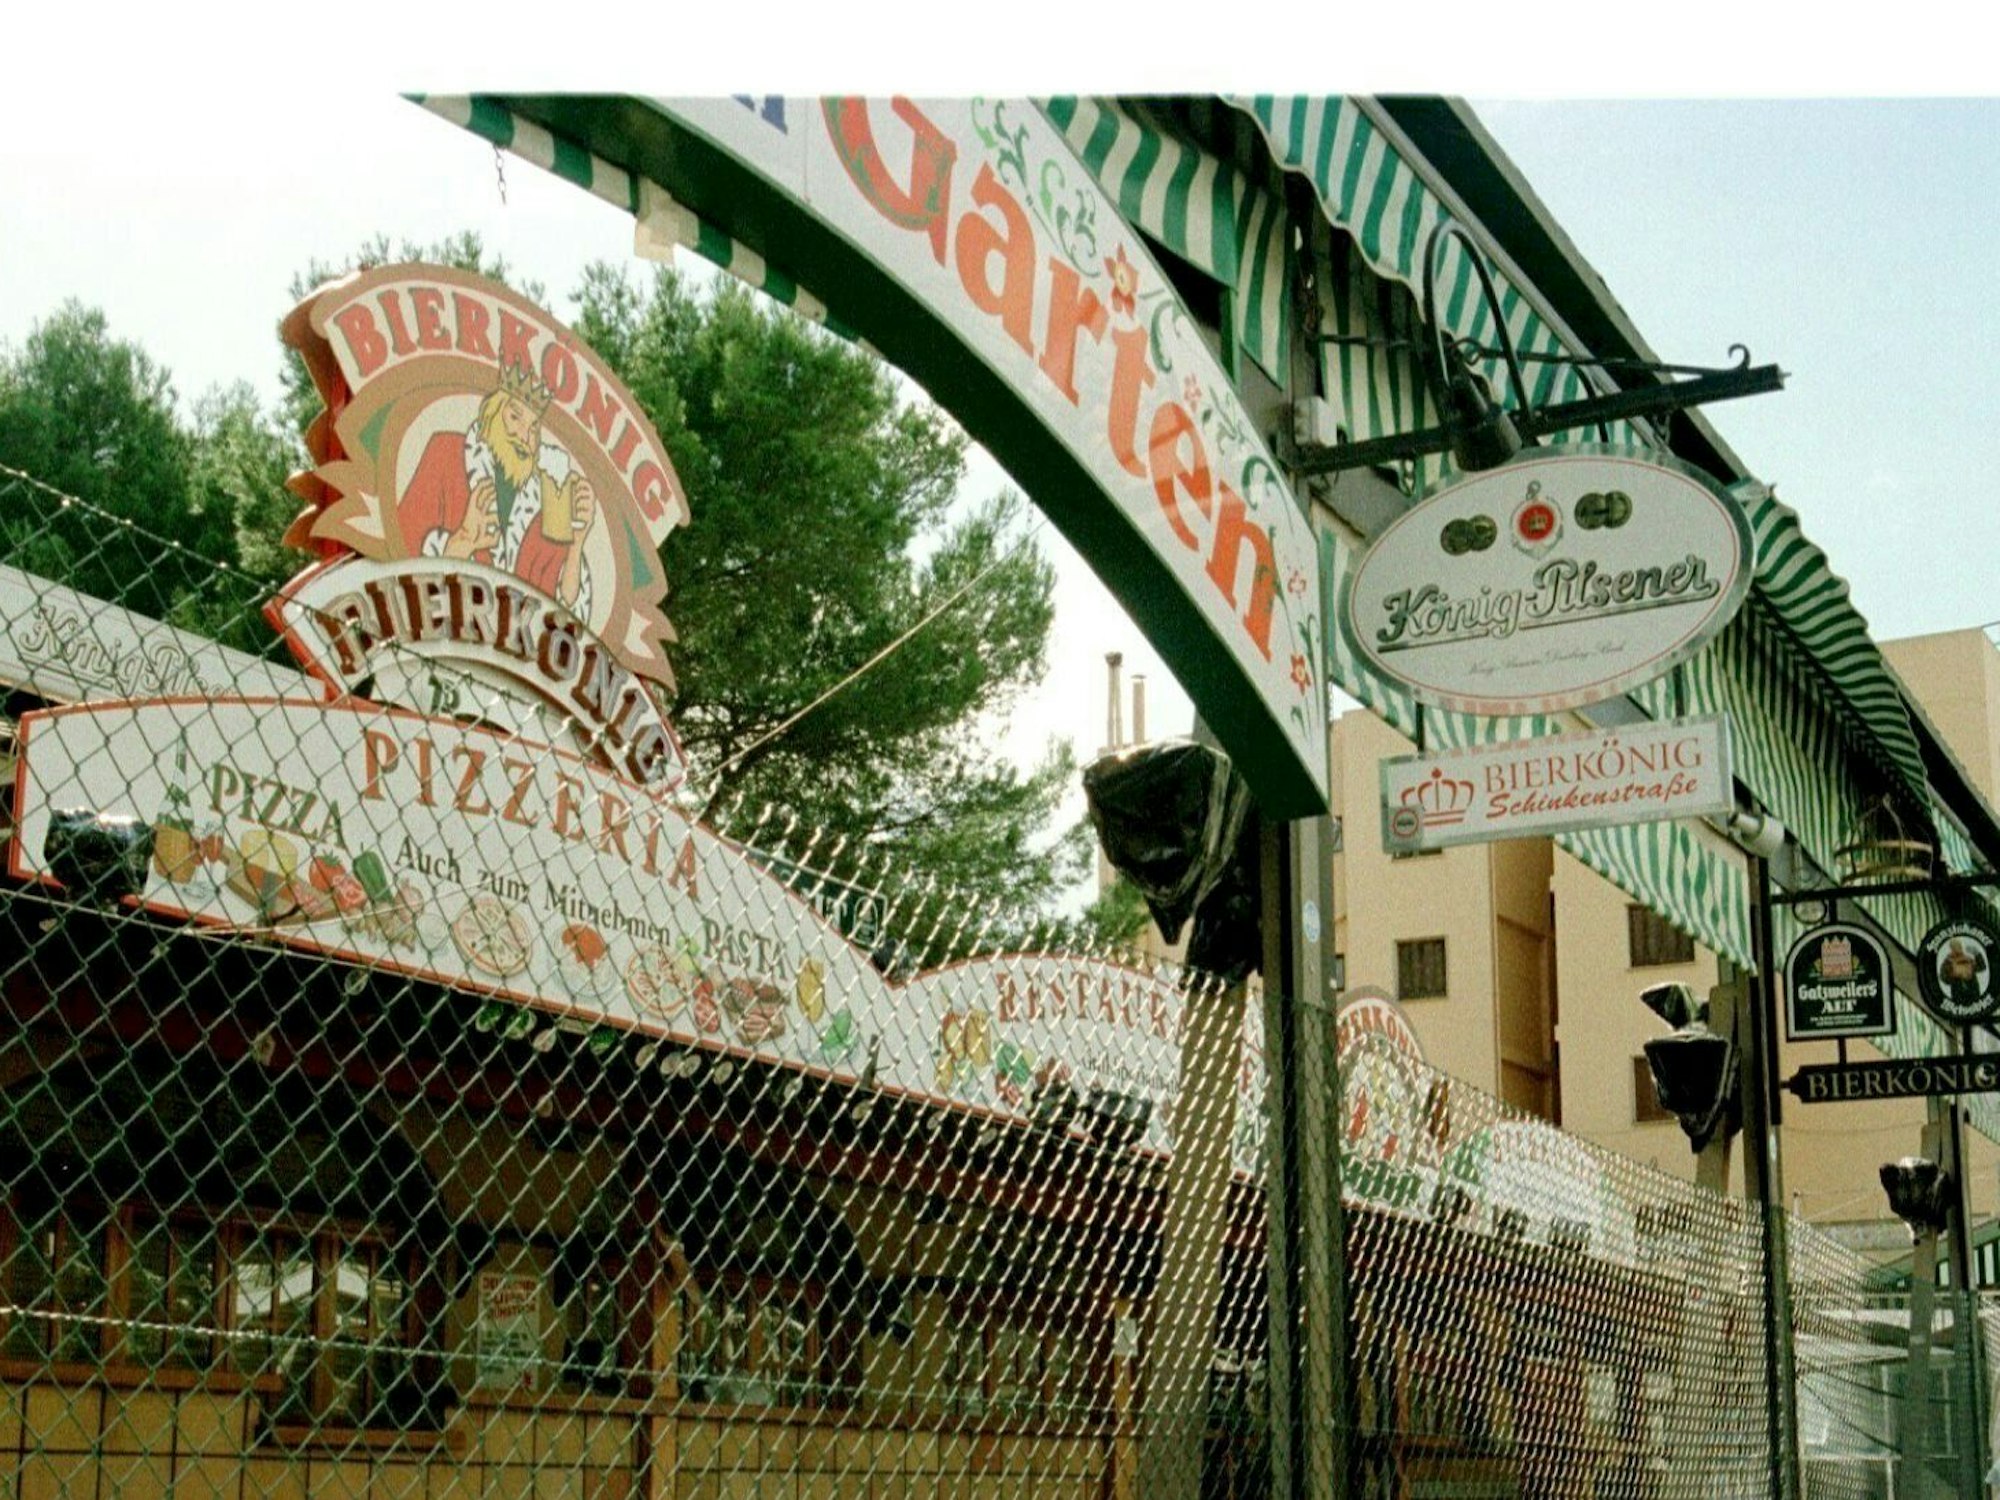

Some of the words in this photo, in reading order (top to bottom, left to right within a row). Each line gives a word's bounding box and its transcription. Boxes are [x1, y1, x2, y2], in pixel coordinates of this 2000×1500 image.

[335, 287, 673, 524] BIERKÖNIG
[819, 94, 1279, 663] Garten
[316, 573, 671, 785] BIERKÖNIG
[209, 763, 347, 851] PIZZA
[359, 729, 699, 898] PIZZERIA
[1485, 736, 1702, 793] BIERKÖNIG
[1486, 772, 1699, 819] Schinkenstraße
[395, 836, 462, 884] Auch
[477, 868, 530, 904] zum
[544, 880, 672, 947] Mitnehmen
[701, 914, 788, 980] PASTA
[1808, 1061, 1997, 1100] BIERKÖNIG
